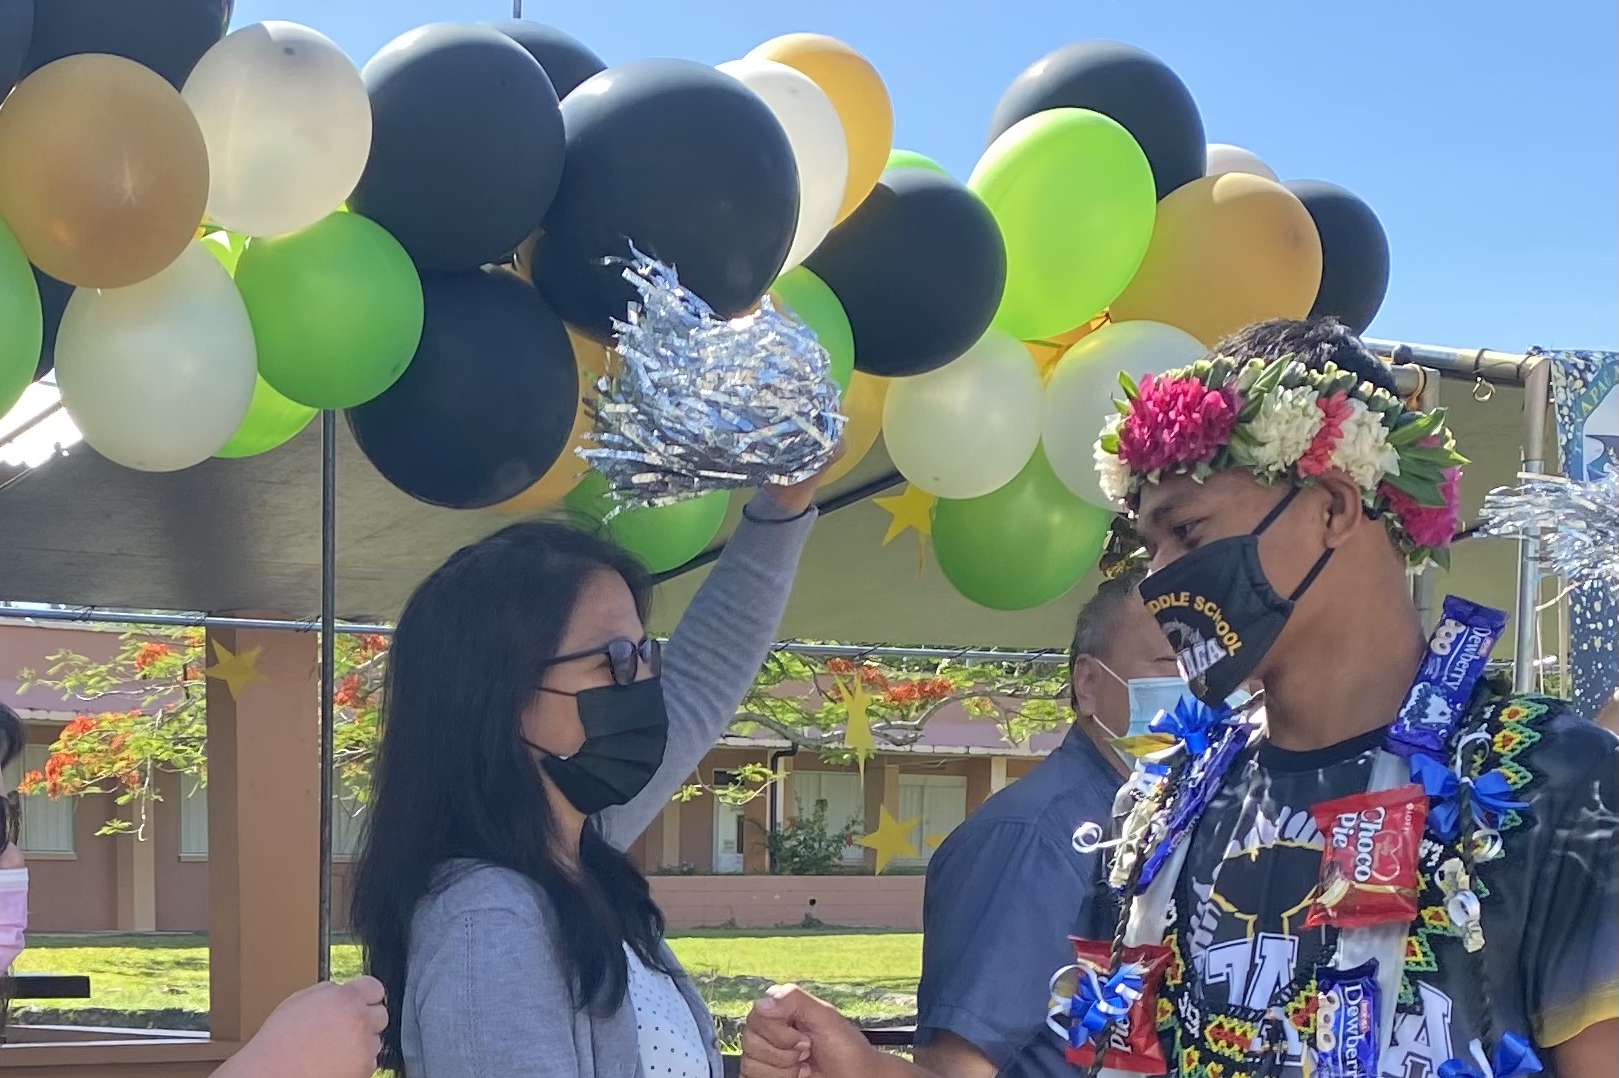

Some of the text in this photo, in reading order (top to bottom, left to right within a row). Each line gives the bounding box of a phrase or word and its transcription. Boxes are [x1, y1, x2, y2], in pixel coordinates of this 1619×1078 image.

[1145, 591, 1243, 657] DDLE SCHOOL
[1442, 626, 1492, 691] Dewberry
[1332, 811, 1359, 849] Pie
[1354, 806, 1386, 882] Choco
